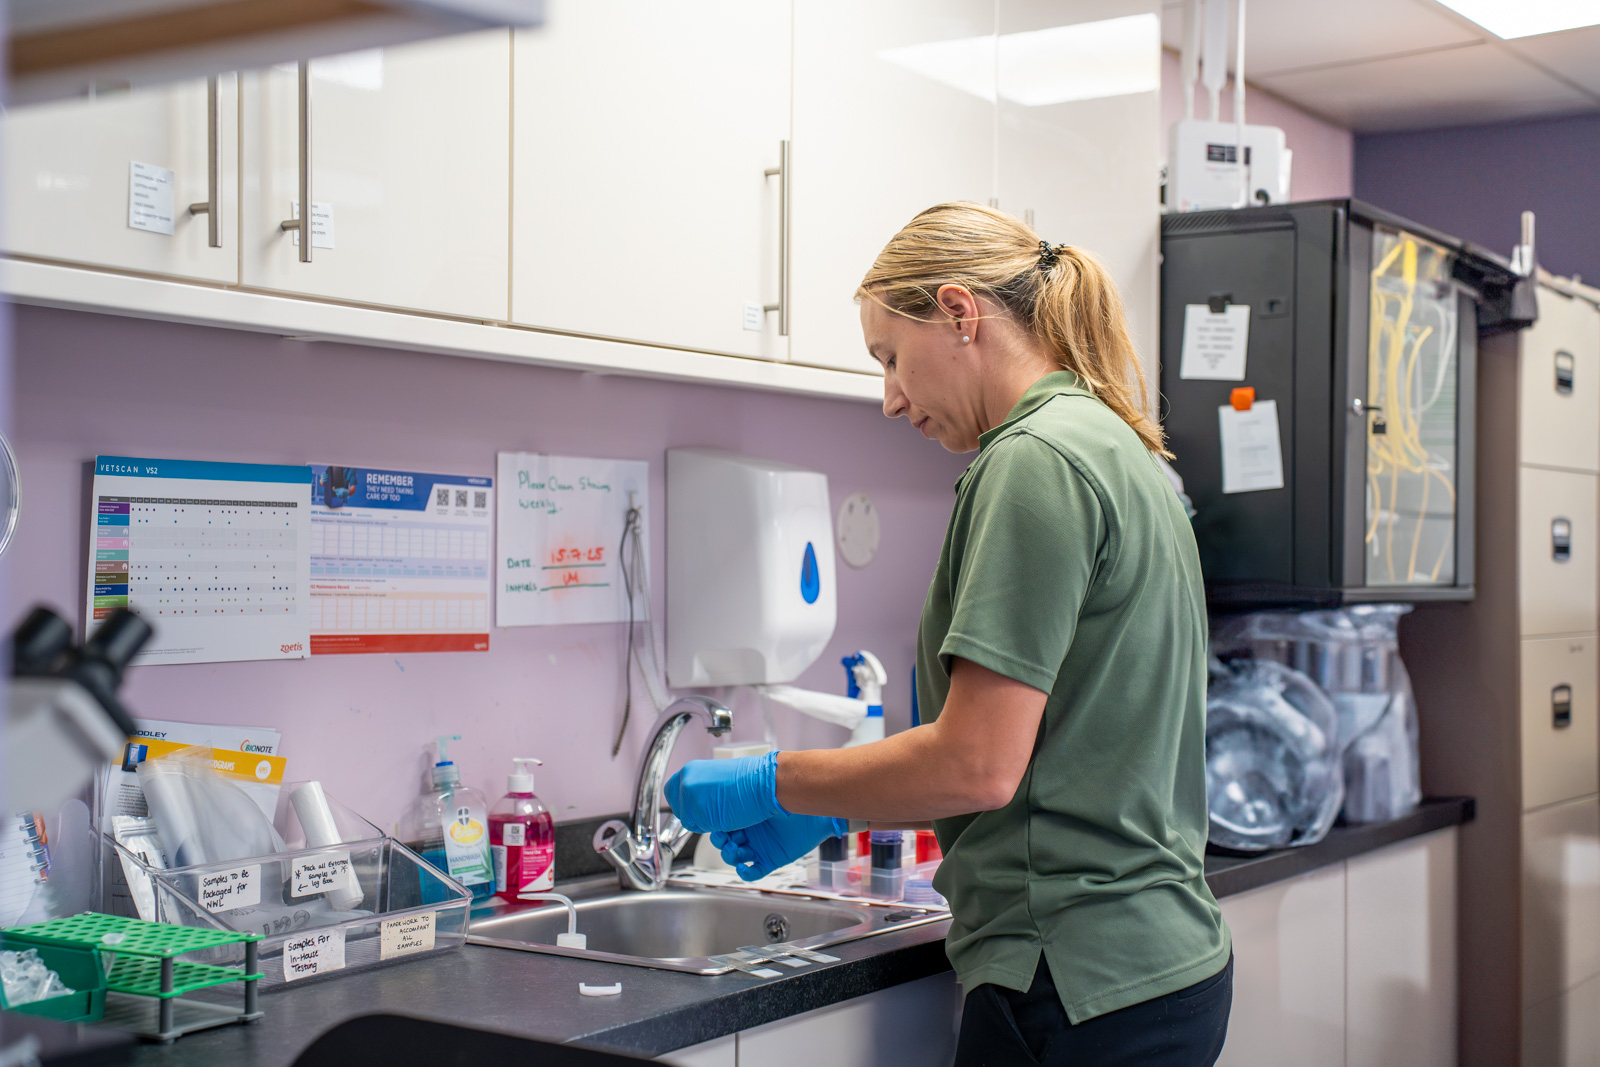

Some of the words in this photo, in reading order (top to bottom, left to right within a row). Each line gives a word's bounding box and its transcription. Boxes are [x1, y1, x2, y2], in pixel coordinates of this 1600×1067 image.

[100, 464, 139, 473] VETSCAN
[145, 466, 158, 475] VS2
[366, 473, 414, 487] REMEMBER
[366, 484, 380, 492] THEY
[381, 486, 394, 494] NEED
[395, 487, 414, 495] TAKING
[366, 492, 380, 500] CARE
[381, 493, 389, 501] OF
[389, 494, 401, 502] TOO
[280, 642, 303, 653] zoetis
[245, 744, 273, 754] BIONOTE
[202, 875, 228, 888] Samples
[203, 885, 232, 900] Packaged
[206, 899, 224, 909] NWL
[399, 923, 430, 934] ACCOMPANY
[288, 937, 315, 951] Samples
[396, 940, 423, 950] SAMPLES
